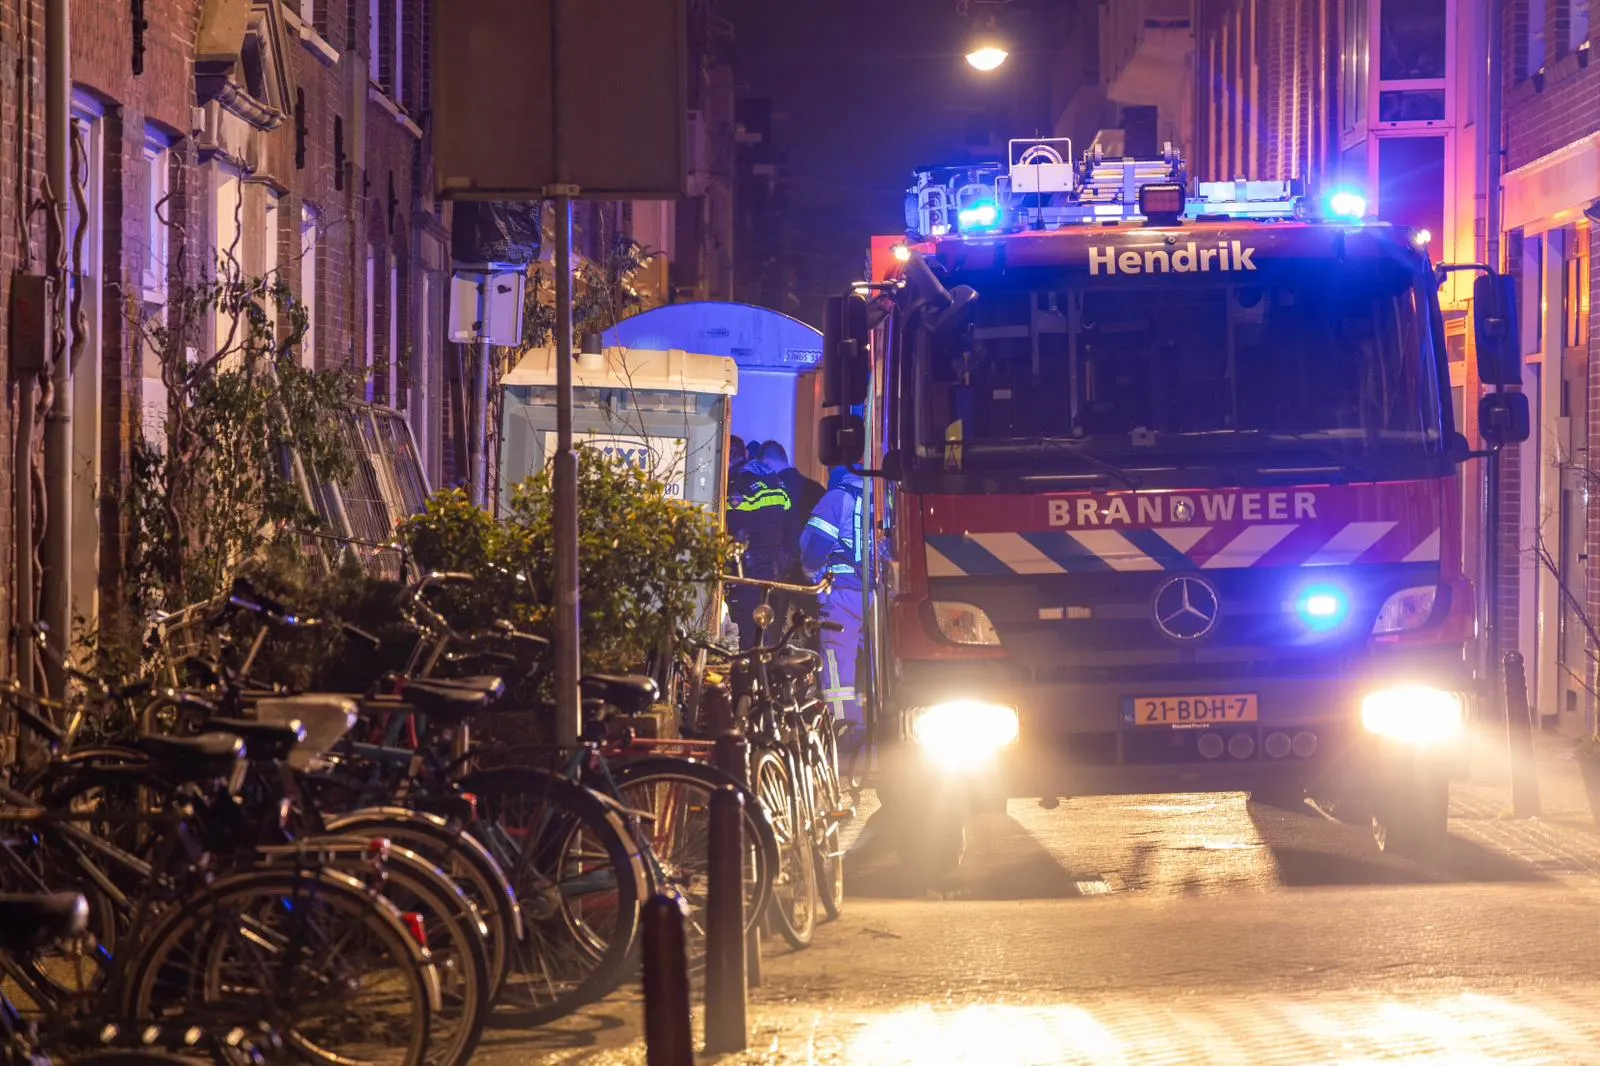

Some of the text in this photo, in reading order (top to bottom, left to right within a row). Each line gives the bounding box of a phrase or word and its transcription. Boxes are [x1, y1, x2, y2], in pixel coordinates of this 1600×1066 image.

[1088, 240, 1257, 275] Hendrik
[1048, 492, 1318, 526] BRANDWEER
[1144, 698, 1248, 721] 21-BDH-7
